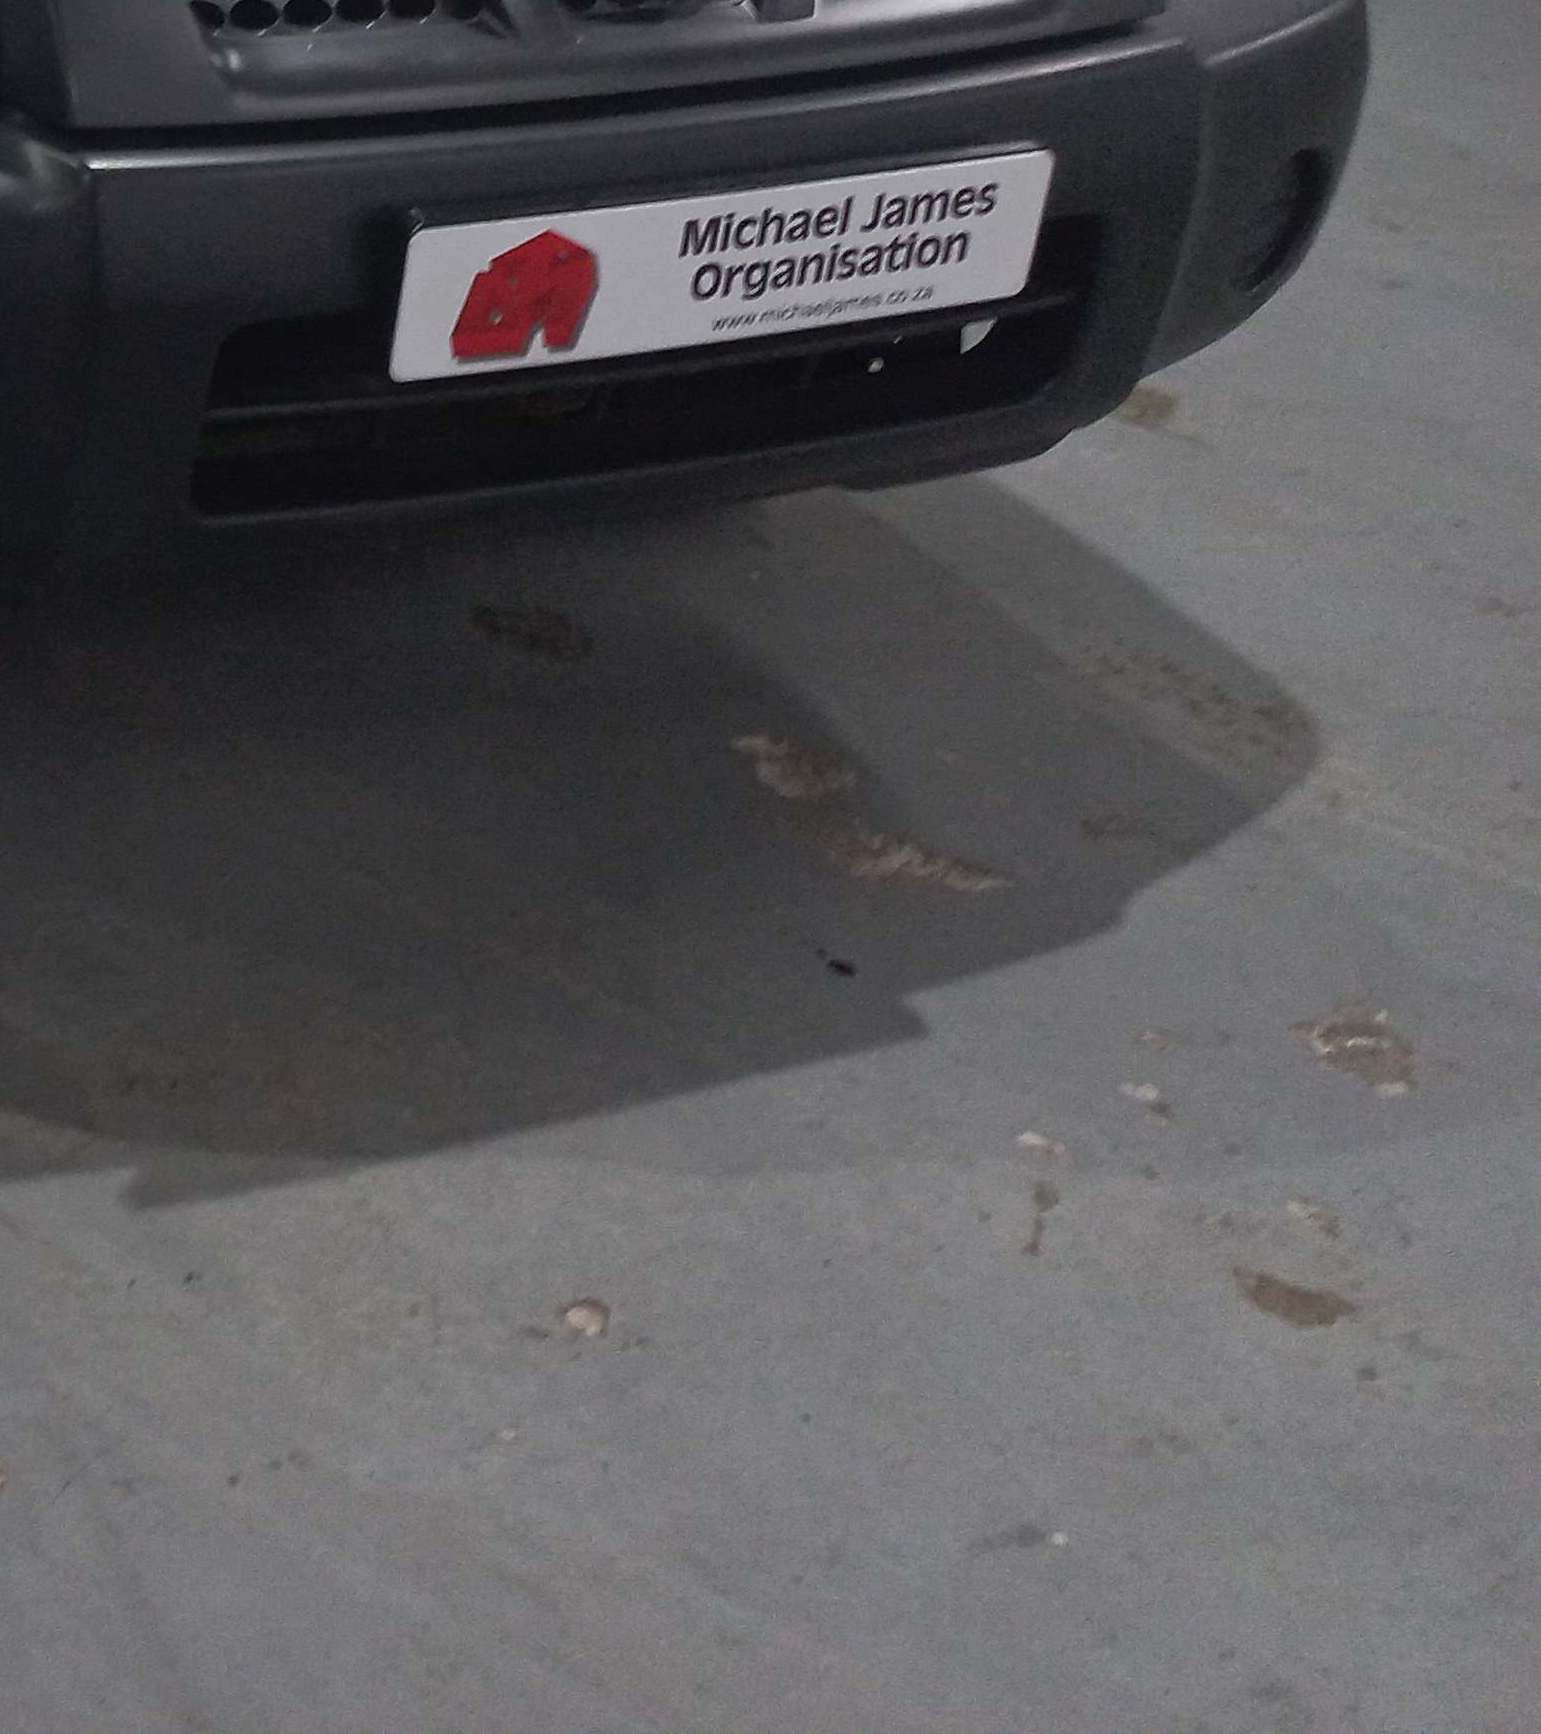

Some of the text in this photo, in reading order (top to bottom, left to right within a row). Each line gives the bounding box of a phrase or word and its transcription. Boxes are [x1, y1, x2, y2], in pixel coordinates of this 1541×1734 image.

[678, 182, 1000, 258] Michael James
[690, 231, 971, 301] Organisation
[712, 285, 934, 332] www.michaeljames.co.za
